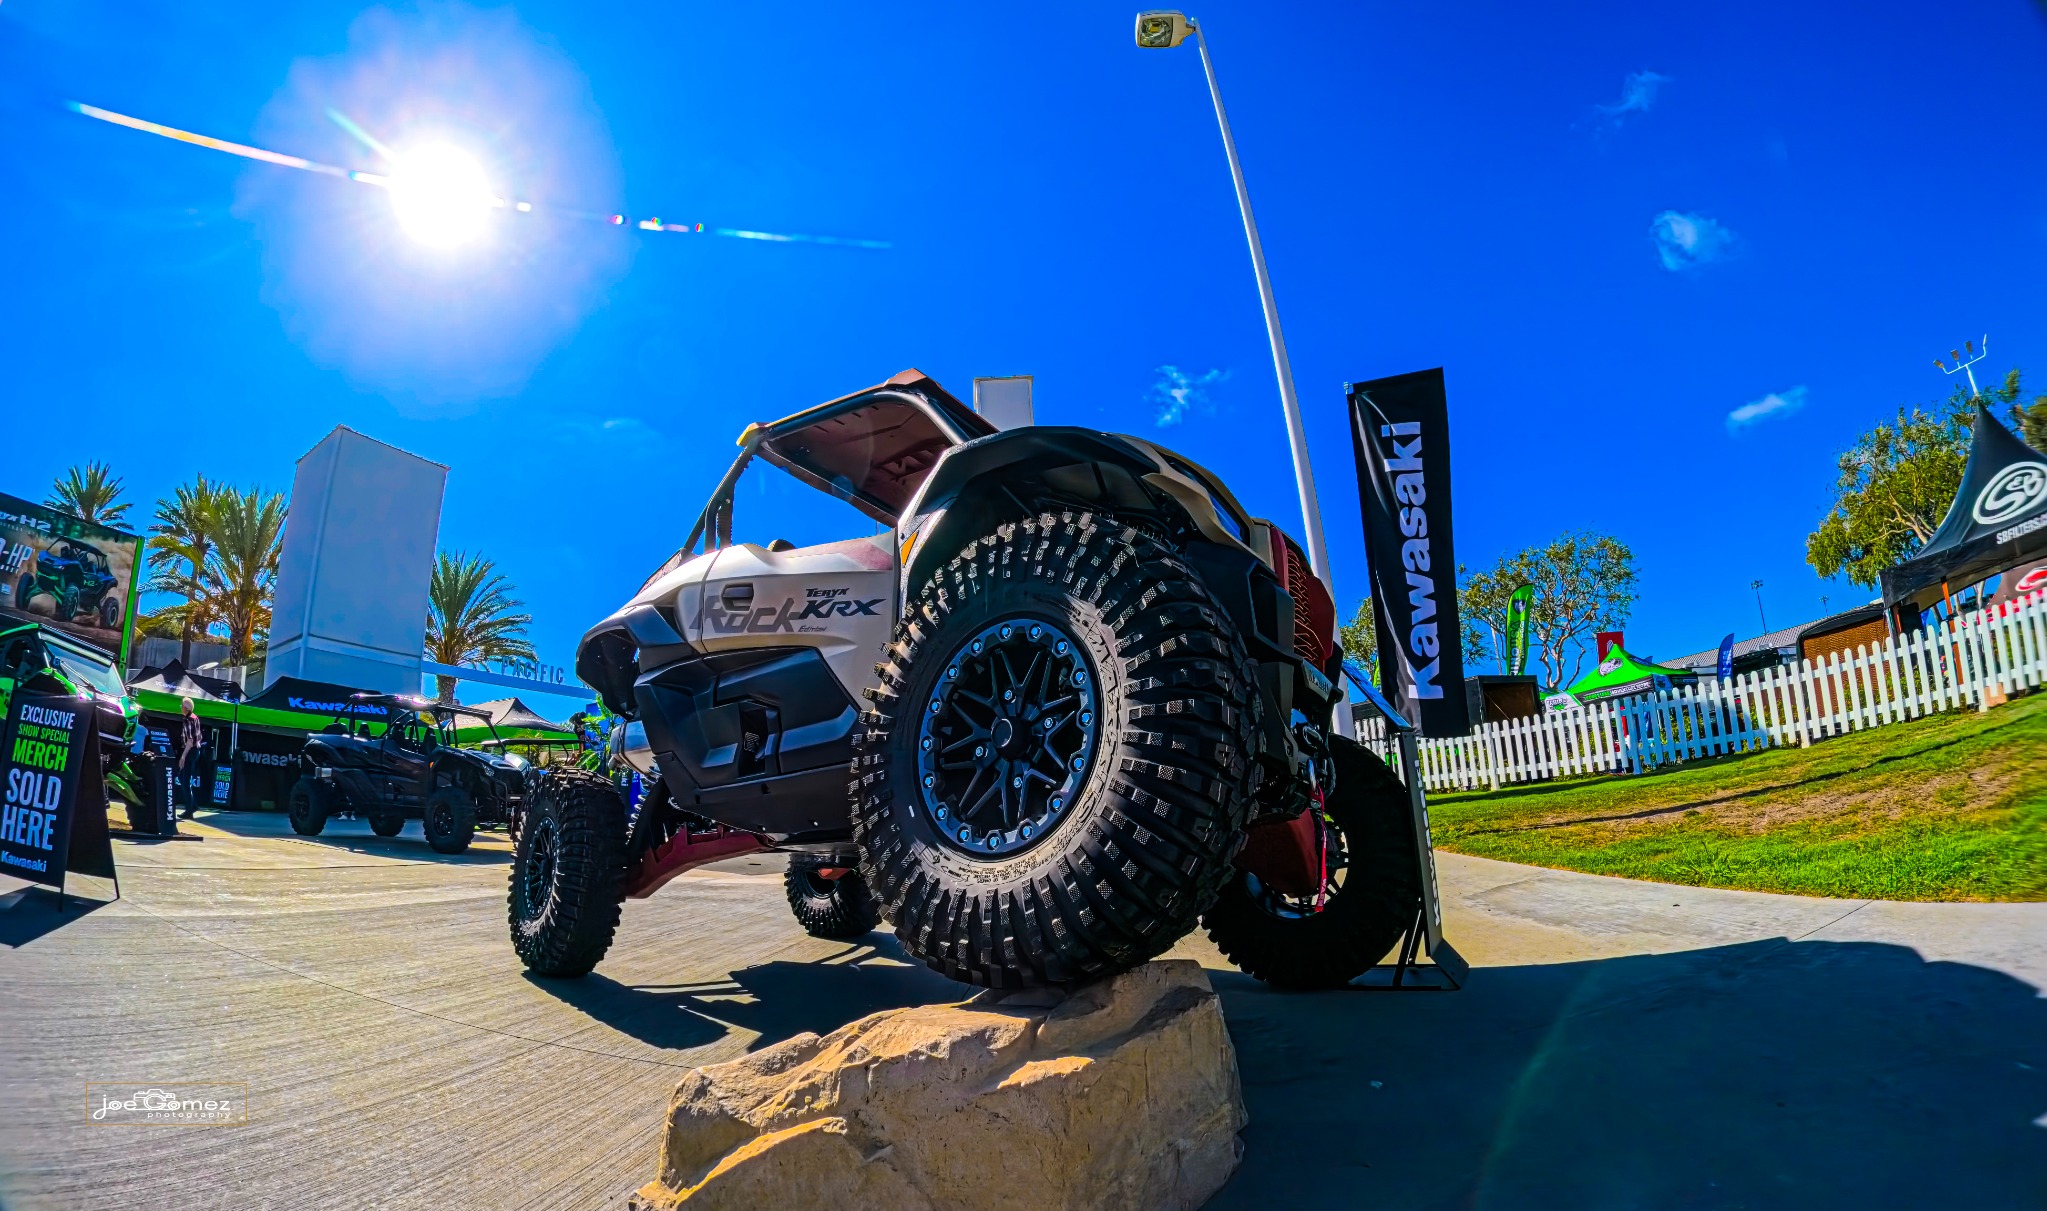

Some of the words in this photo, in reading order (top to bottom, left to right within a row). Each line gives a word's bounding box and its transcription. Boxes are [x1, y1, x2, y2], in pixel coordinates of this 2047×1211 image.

[1381, 421, 1444, 699] Kawasaki
[798, 598, 887, 621] KRX
[501, 656, 564, 684] PACIFIC
[20, 704, 76, 730] EXCLUSIVE
[18, 723, 40, 738] SHOW
[40, 727, 70, 744] SPECIAL
[12, 737, 69, 772] MERCH
[242, 750, 302, 768] awasaki
[6, 768, 62, 811] SOLD
[165, 766, 174, 821] Kawasaki
[0, 804, 57, 851] HERE
[1, 850, 47, 872] Kawasaki
